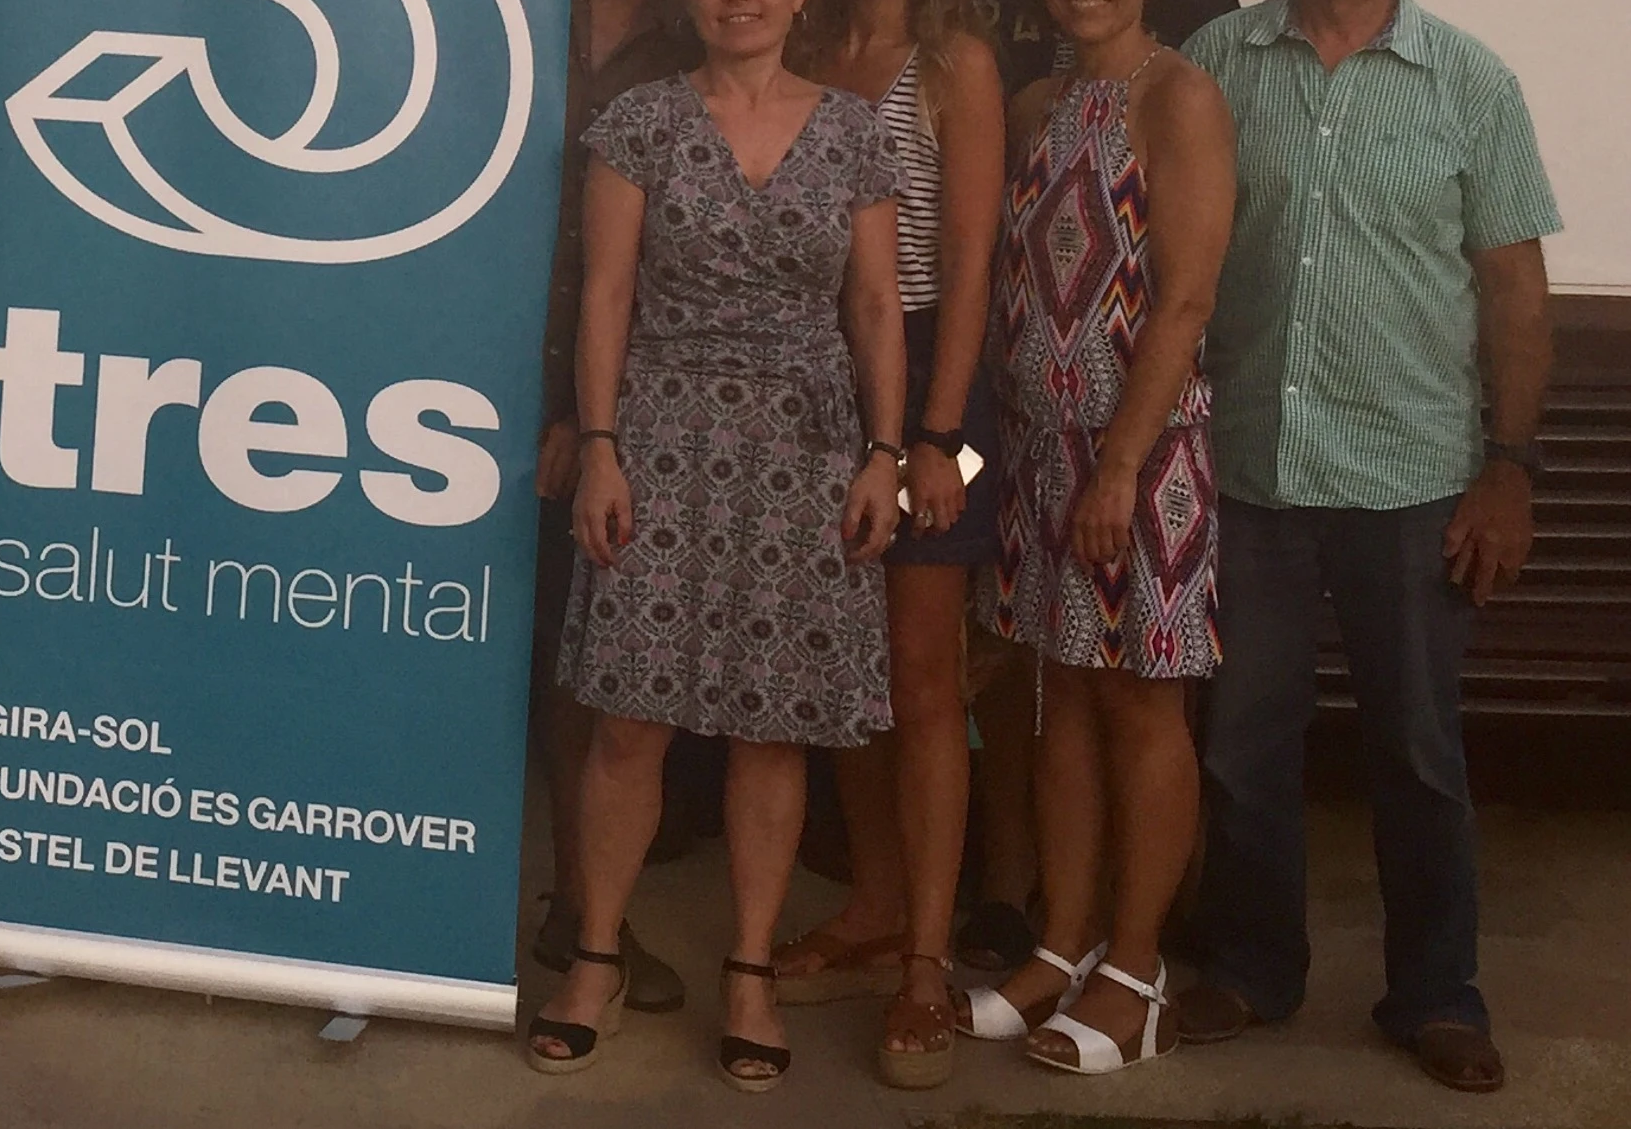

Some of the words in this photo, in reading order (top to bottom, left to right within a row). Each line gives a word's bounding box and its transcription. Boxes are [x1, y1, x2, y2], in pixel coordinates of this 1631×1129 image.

[207, 560, 490, 642] mental
[190, 790, 240, 826] ES
[248, 797, 476, 853] GARROVER
[105, 842, 160, 879] DE
[170, 850, 350, 902] LLEVANT
